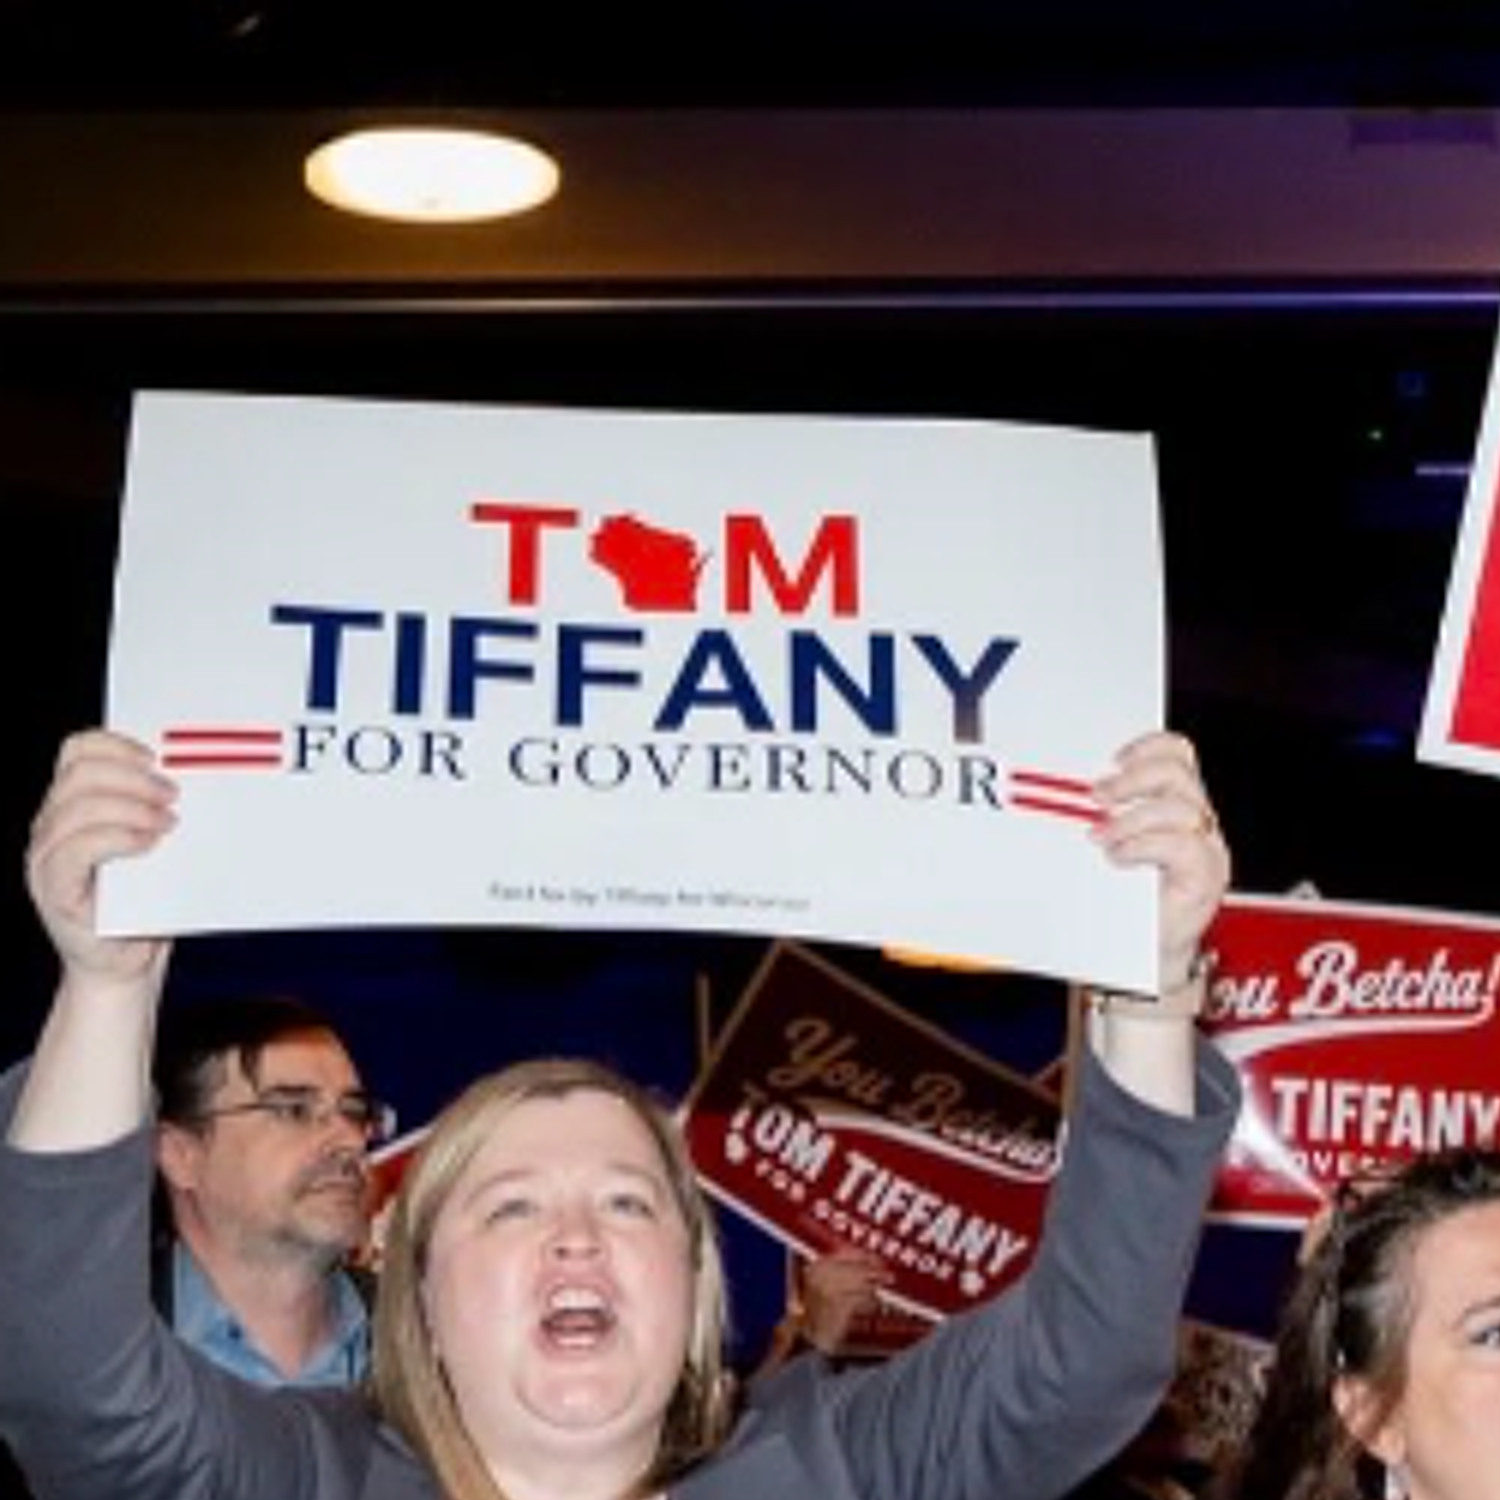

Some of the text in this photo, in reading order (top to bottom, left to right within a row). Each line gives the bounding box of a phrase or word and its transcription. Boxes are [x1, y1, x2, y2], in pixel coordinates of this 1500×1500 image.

[270, 604, 1020, 743] TIFFANY
[292, 724, 1004, 810] FOR GOVERNOR
[768, 1018, 1053, 1167] You Betcha
[835, 1150, 1028, 1275] TIFFANY
